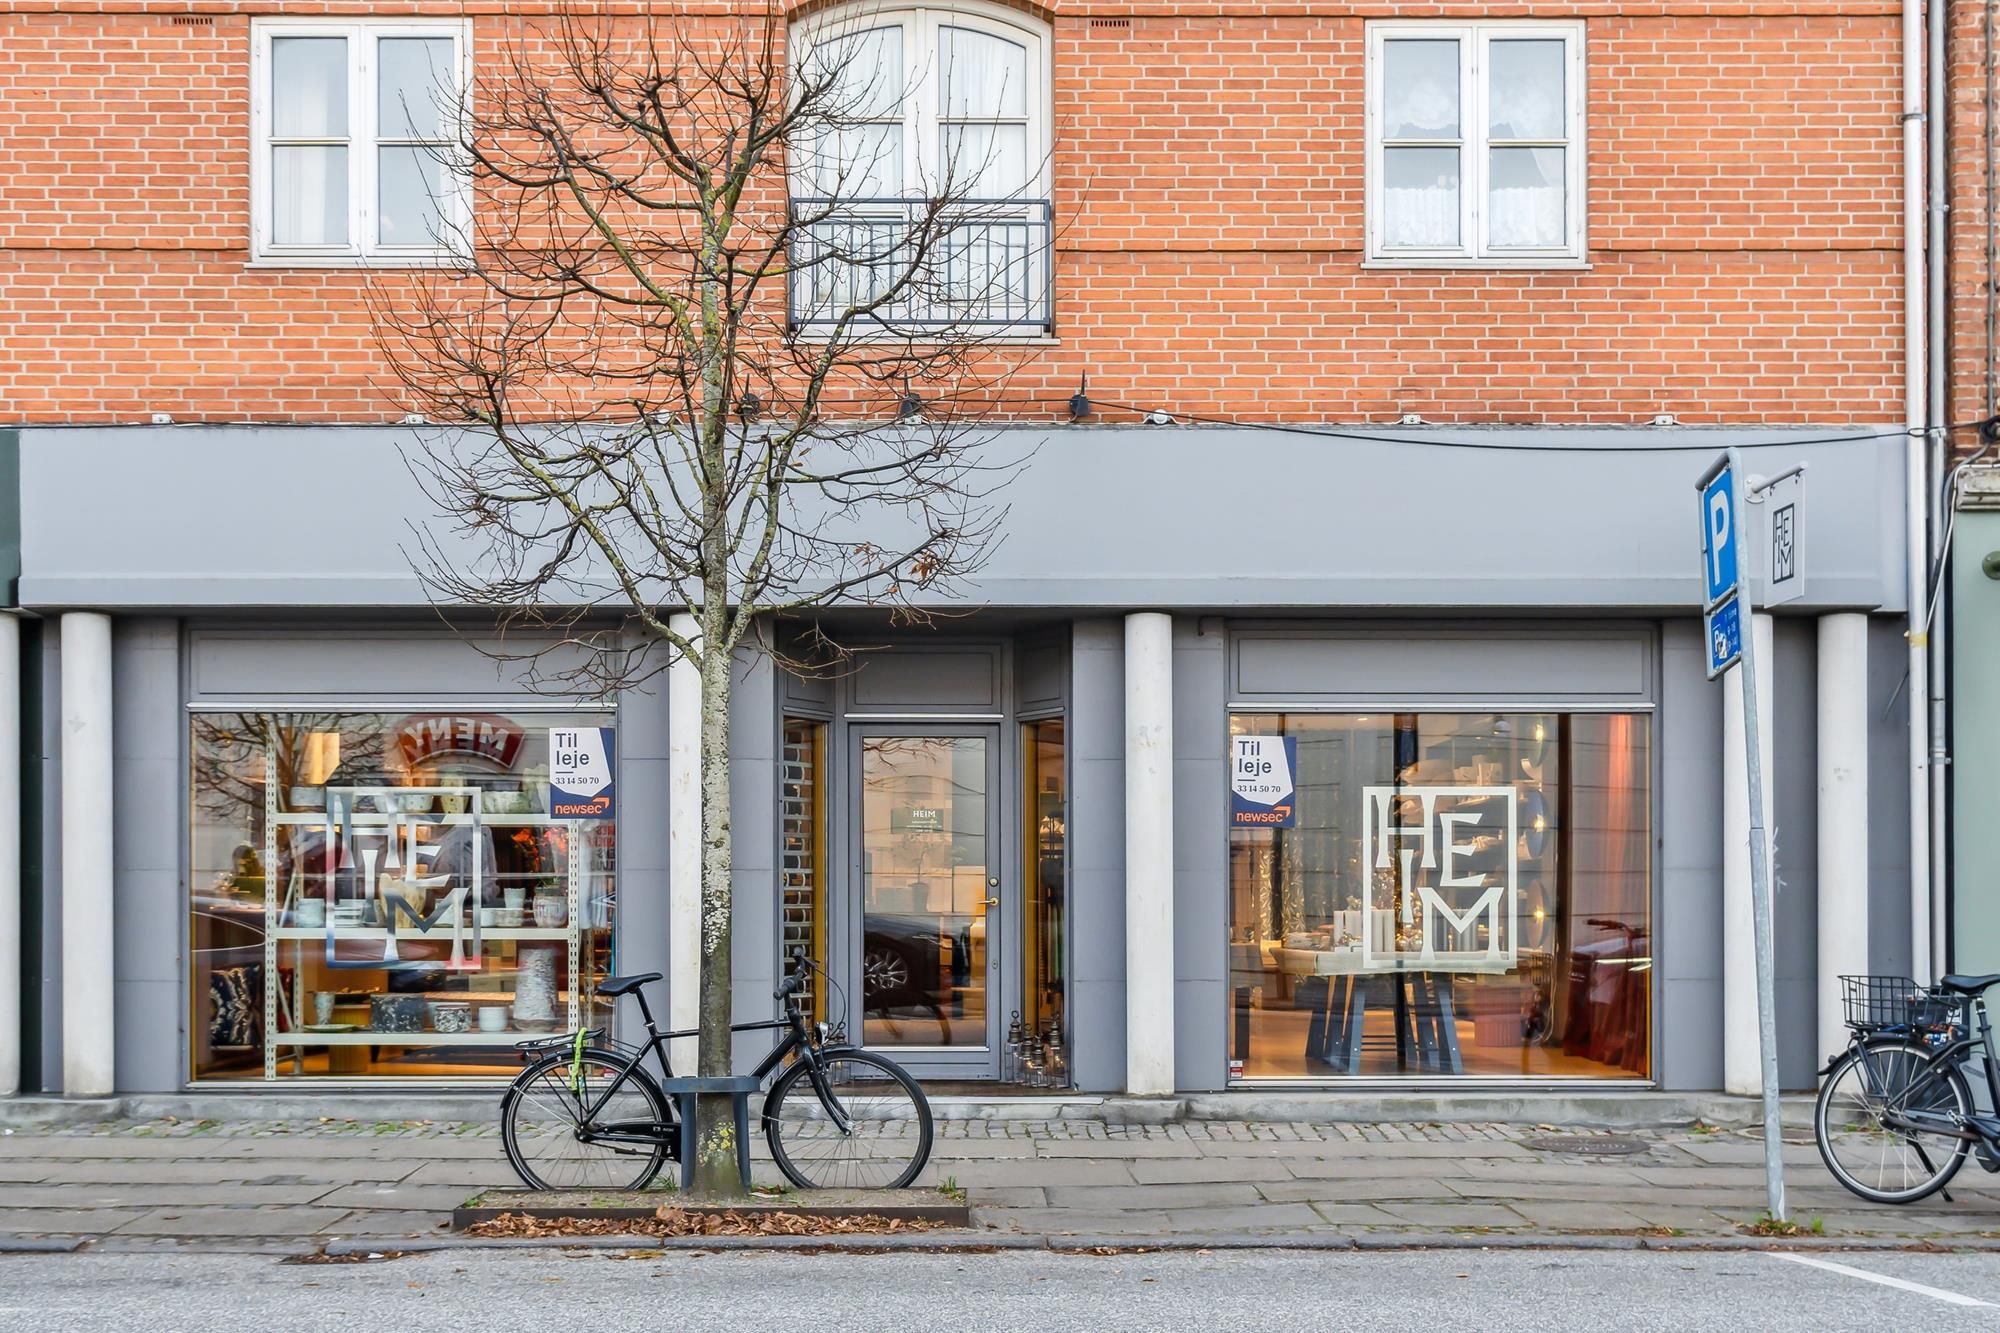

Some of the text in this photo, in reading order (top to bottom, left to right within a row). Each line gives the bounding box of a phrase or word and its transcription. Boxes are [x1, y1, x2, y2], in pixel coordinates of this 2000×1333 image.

[1710, 489, 1729, 586] P
[555, 733, 577, 748] Til
[1238, 741, 1260, 755] Til
[556, 750, 589, 768] leje
[1239, 758, 1272, 776] leje
[555, 805, 602, 814] newsec
[912, 810, 936, 818] HEIM
[1236, 813, 1283, 822] newsec
